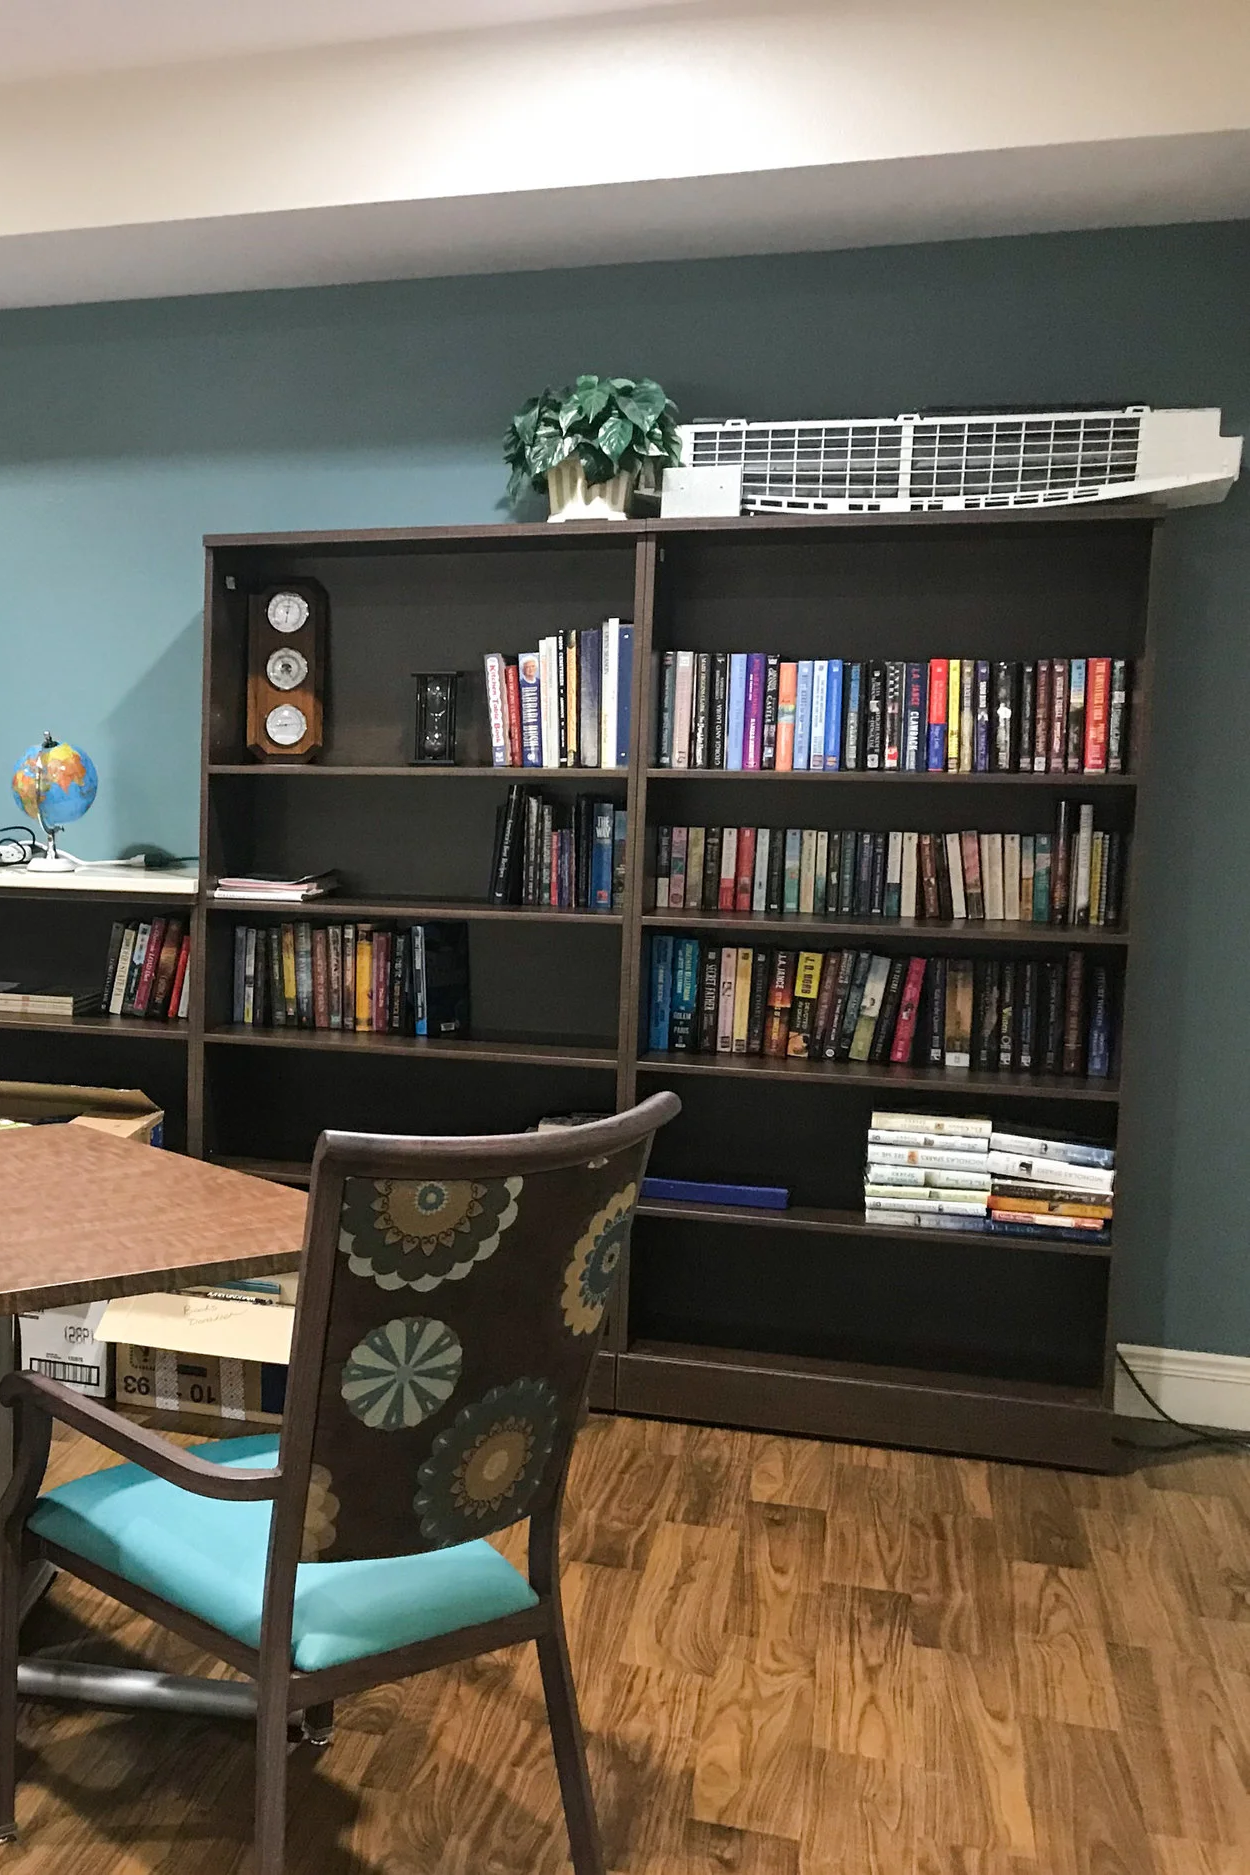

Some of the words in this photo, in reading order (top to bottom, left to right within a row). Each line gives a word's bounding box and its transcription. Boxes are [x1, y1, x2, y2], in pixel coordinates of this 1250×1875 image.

[522, 687, 538, 723] BARBARA
[523, 725, 539, 747] BUSH
[909, 711, 919, 751] CLAWBACK
[705, 964, 717, 985] SECRET
[775, 968, 785, 989] JANCE
[704, 987, 715, 1011] FATHER
[920, 1156, 944, 1164] SPARKS
[946, 1157, 984, 1166] NICHOLAS
